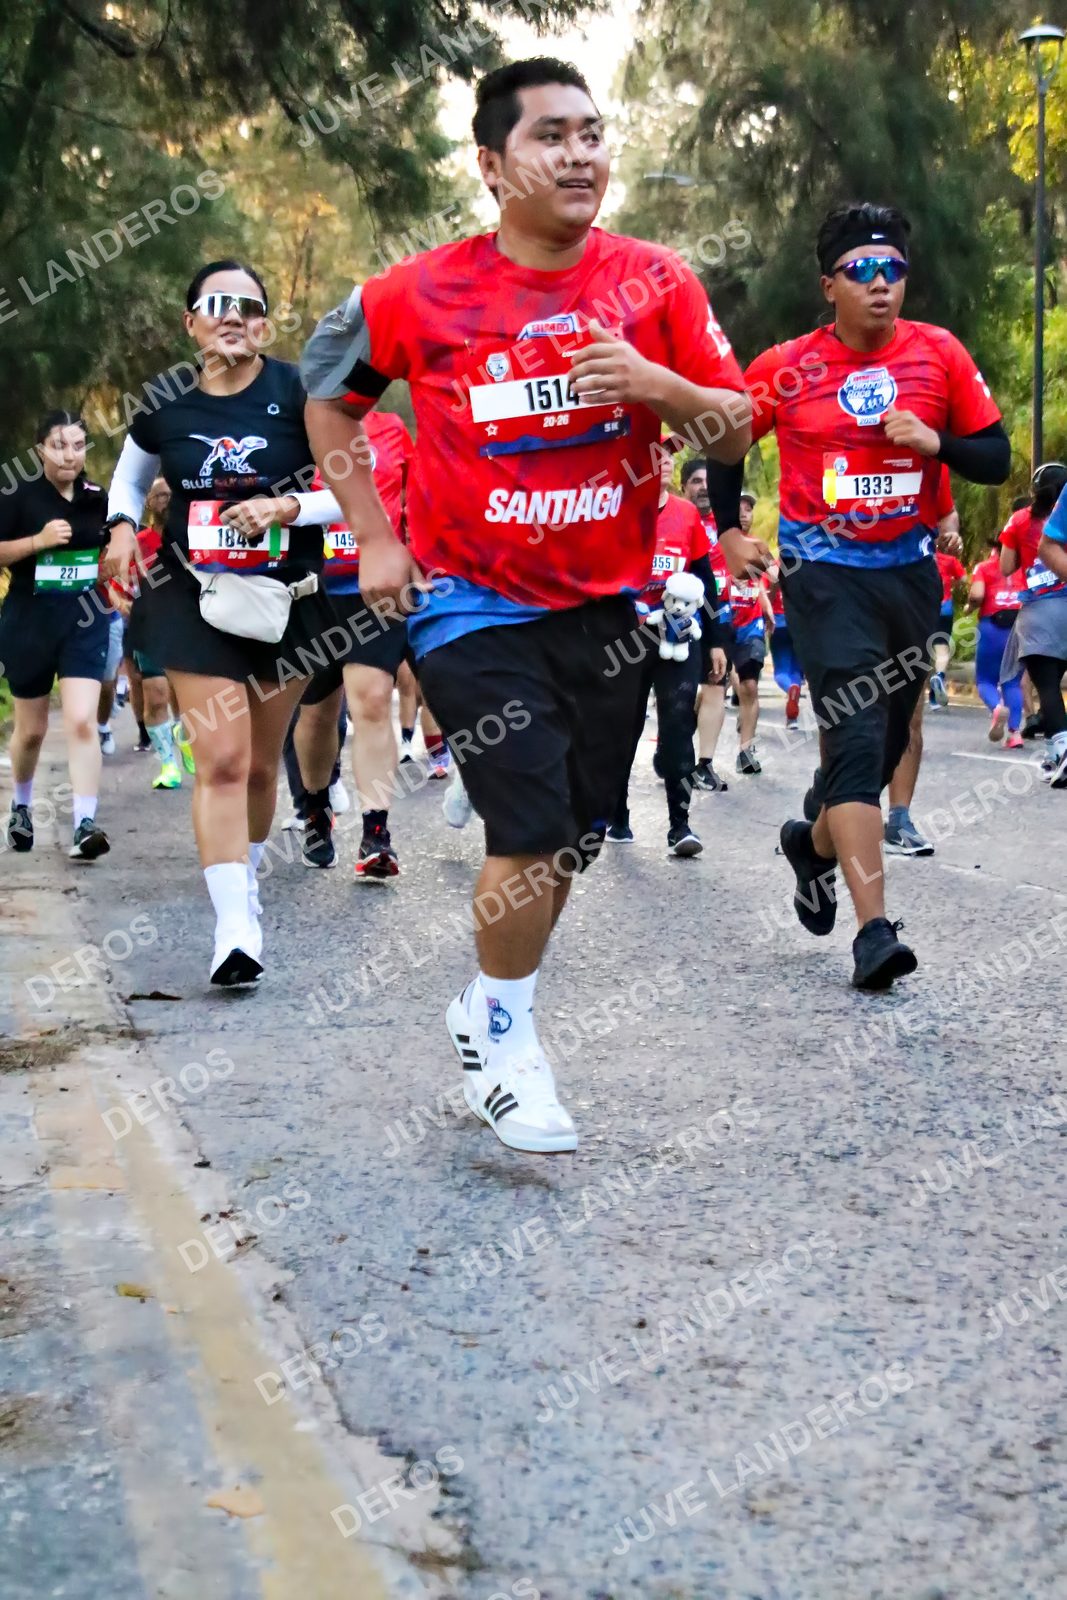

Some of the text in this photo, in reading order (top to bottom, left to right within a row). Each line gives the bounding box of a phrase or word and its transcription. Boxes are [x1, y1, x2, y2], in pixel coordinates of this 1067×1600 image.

[181, 478, 213, 490] BLUE
[854, 476, 892, 496] 1333
[485, 484, 623, 524] SANTIAGO
[217, 527, 247, 548] 184
[60, 567, 78, 579] 221
